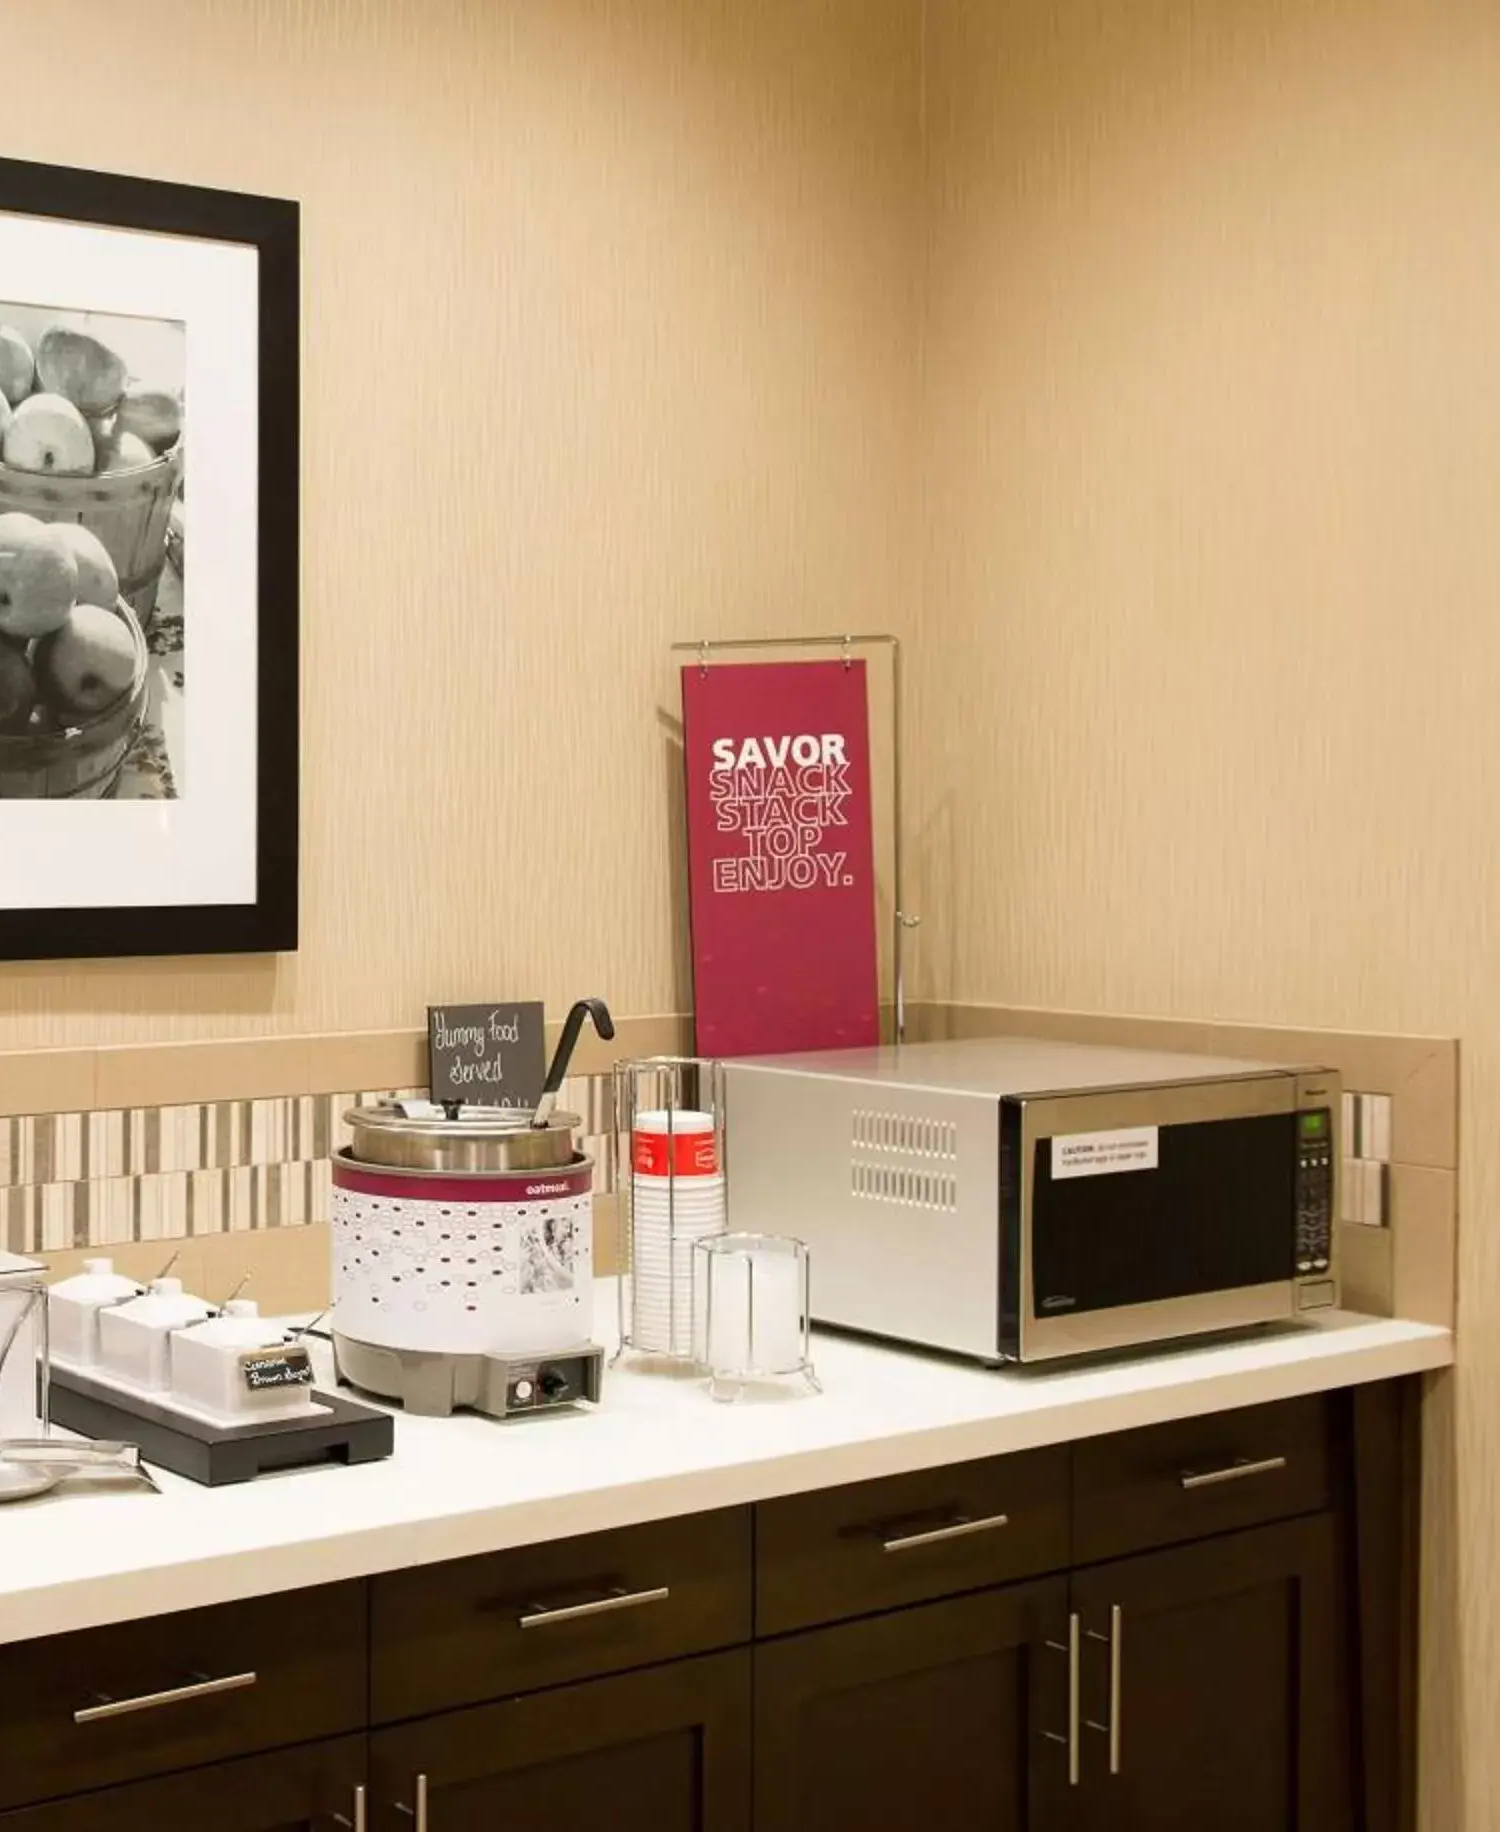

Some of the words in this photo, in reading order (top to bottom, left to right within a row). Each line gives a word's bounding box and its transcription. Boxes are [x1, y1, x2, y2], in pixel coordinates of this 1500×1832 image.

[712, 734, 846, 769] SAVOR
[709, 762, 853, 801] SNACK
[716, 793, 849, 831] STACK
[743, 825, 822, 862] TOP
[713, 852, 854, 892] ENJOY.
[434, 1011, 485, 1057] Yummy
